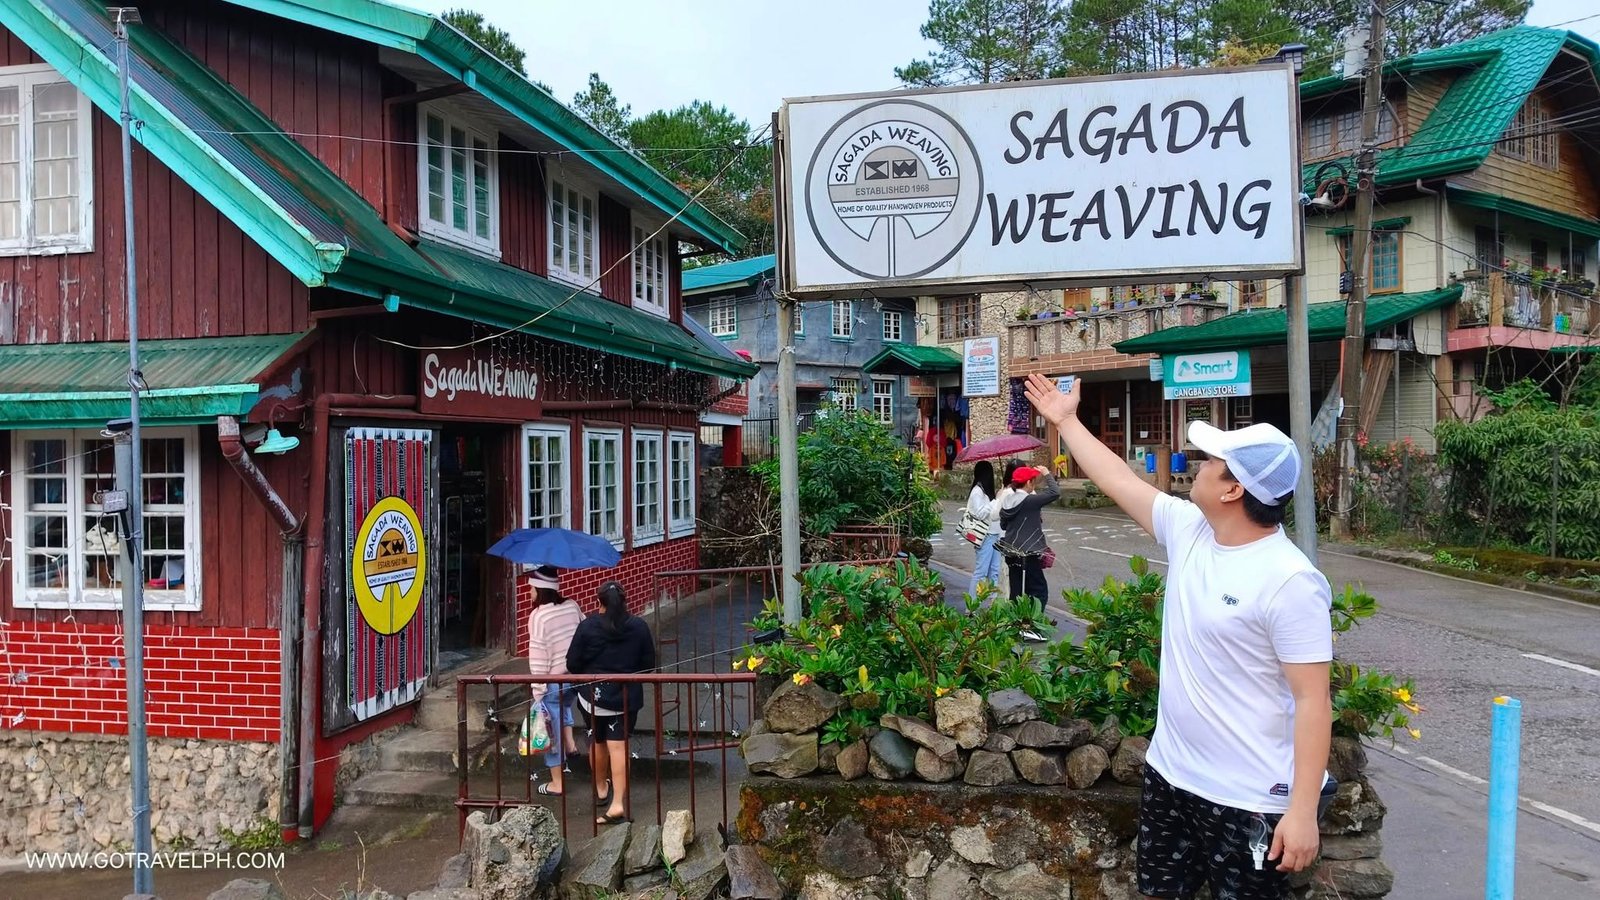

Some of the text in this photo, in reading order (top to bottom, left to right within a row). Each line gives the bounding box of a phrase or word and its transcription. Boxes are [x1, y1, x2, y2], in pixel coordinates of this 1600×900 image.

[1003, 95, 1251, 165] SAGADA
[835, 125, 951, 182] SAGADA WEAVING
[837, 205, 855, 213] HOME
[856, 204, 864, 212] OF
[865, 203, 887, 211] QUALITY
[923, 200, 953, 208] PRODUCTS
[855, 184, 930, 196] ESTABLISHED 1968
[986, 178, 1272, 247] WEAVING
[424, 353, 538, 401] Sagada WEAVING
[1193, 359, 1233, 375] Smart
[1213, 385, 1237, 395] STORE
[366, 513, 416, 559] SAGADA WEAVING
